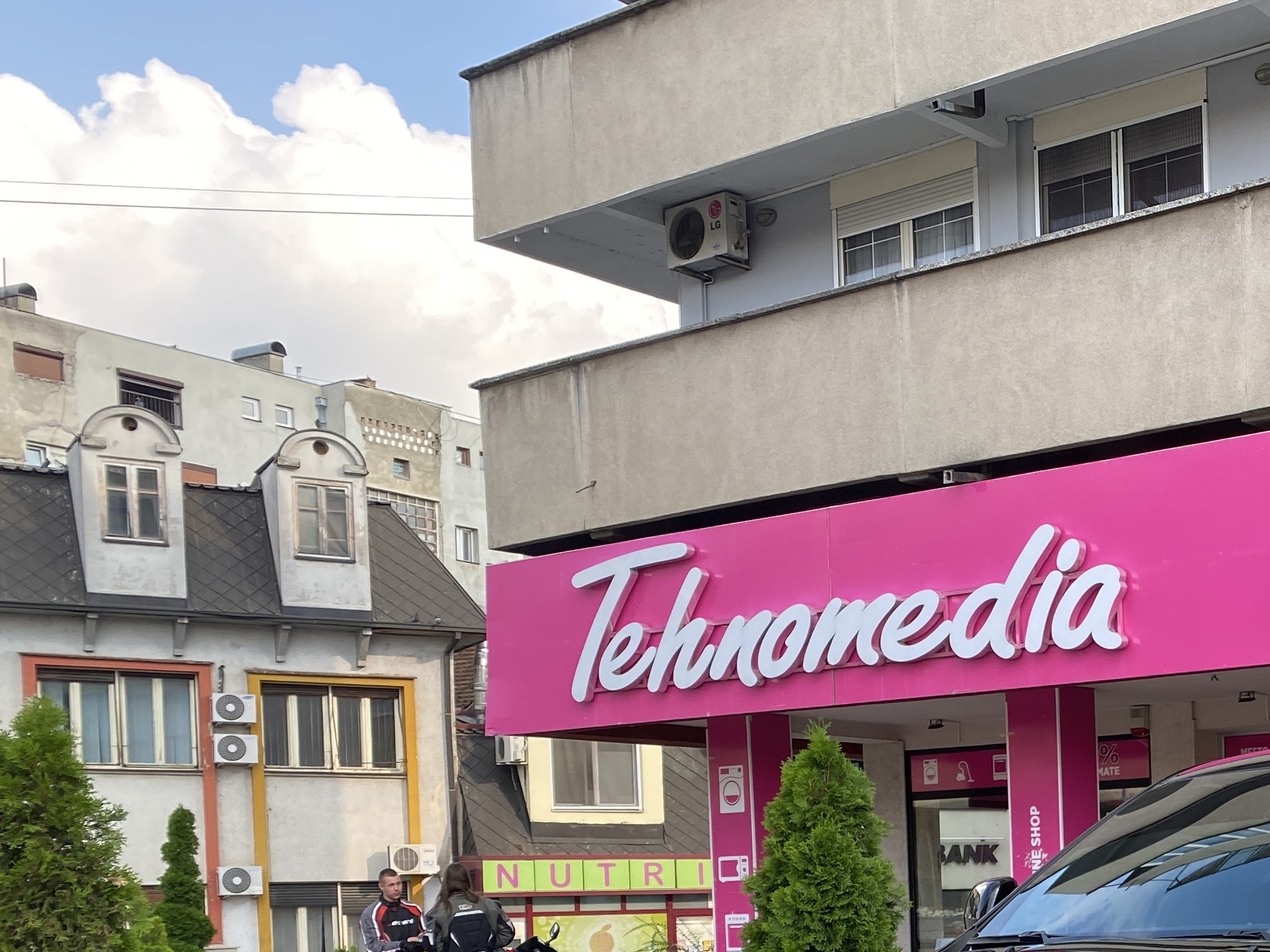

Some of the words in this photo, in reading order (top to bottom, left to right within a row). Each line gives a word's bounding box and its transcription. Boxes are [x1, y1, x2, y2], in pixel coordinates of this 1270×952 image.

[710, 220, 721, 231] LG
[569, 522, 1126, 703] Tehnomedia
[1030, 805, 1041, 847] SHOP
[938, 844, 999, 866] BANK
[496, 862, 704, 889] NUTRI
